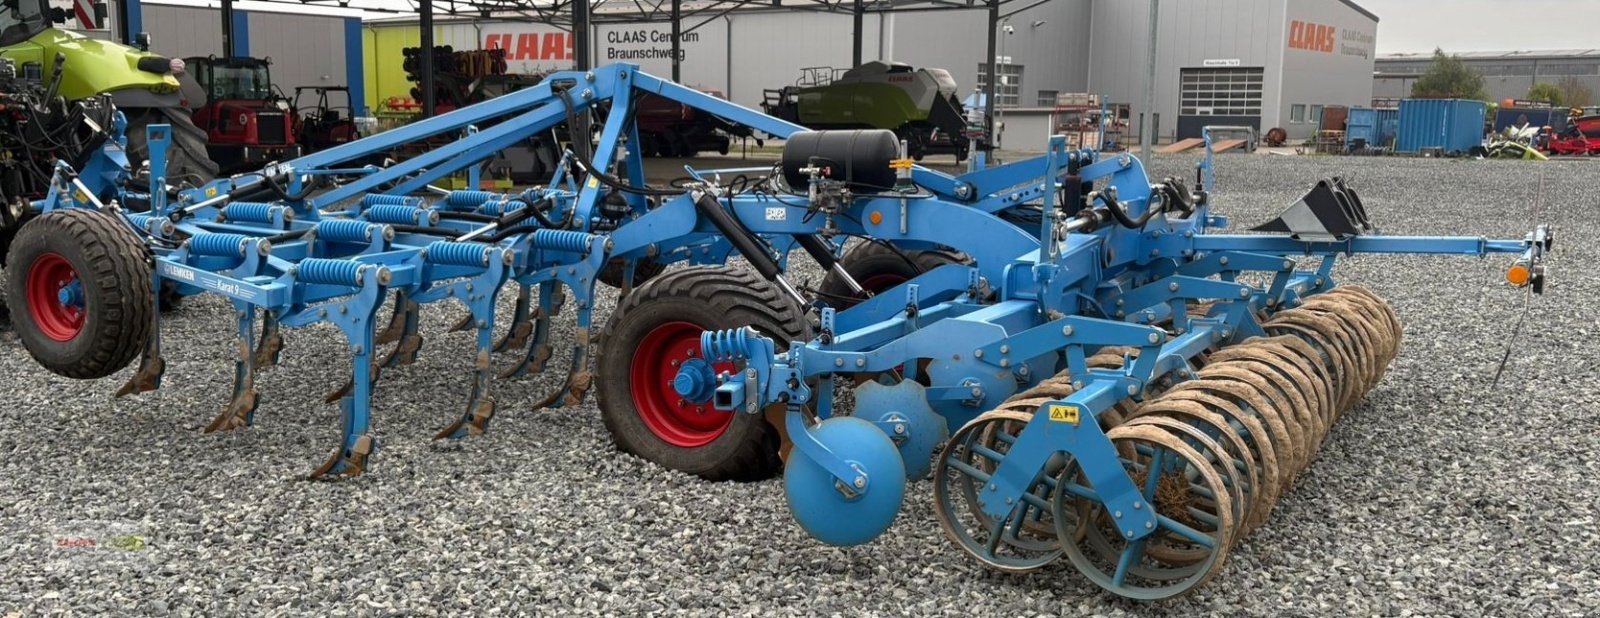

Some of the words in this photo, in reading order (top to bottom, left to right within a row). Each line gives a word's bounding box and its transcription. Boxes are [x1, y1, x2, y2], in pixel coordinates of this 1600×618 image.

[607, 30, 647, 43] CLAAS
[650, 30, 699, 42] Cenum
[1288, 20, 1335, 53] CLAAS
[607, 46, 685, 62] Braunschweg
[170, 264, 195, 281] LEMKEN
[216, 279, 235, 295] Karat
[234, 286, 240, 295] 9
